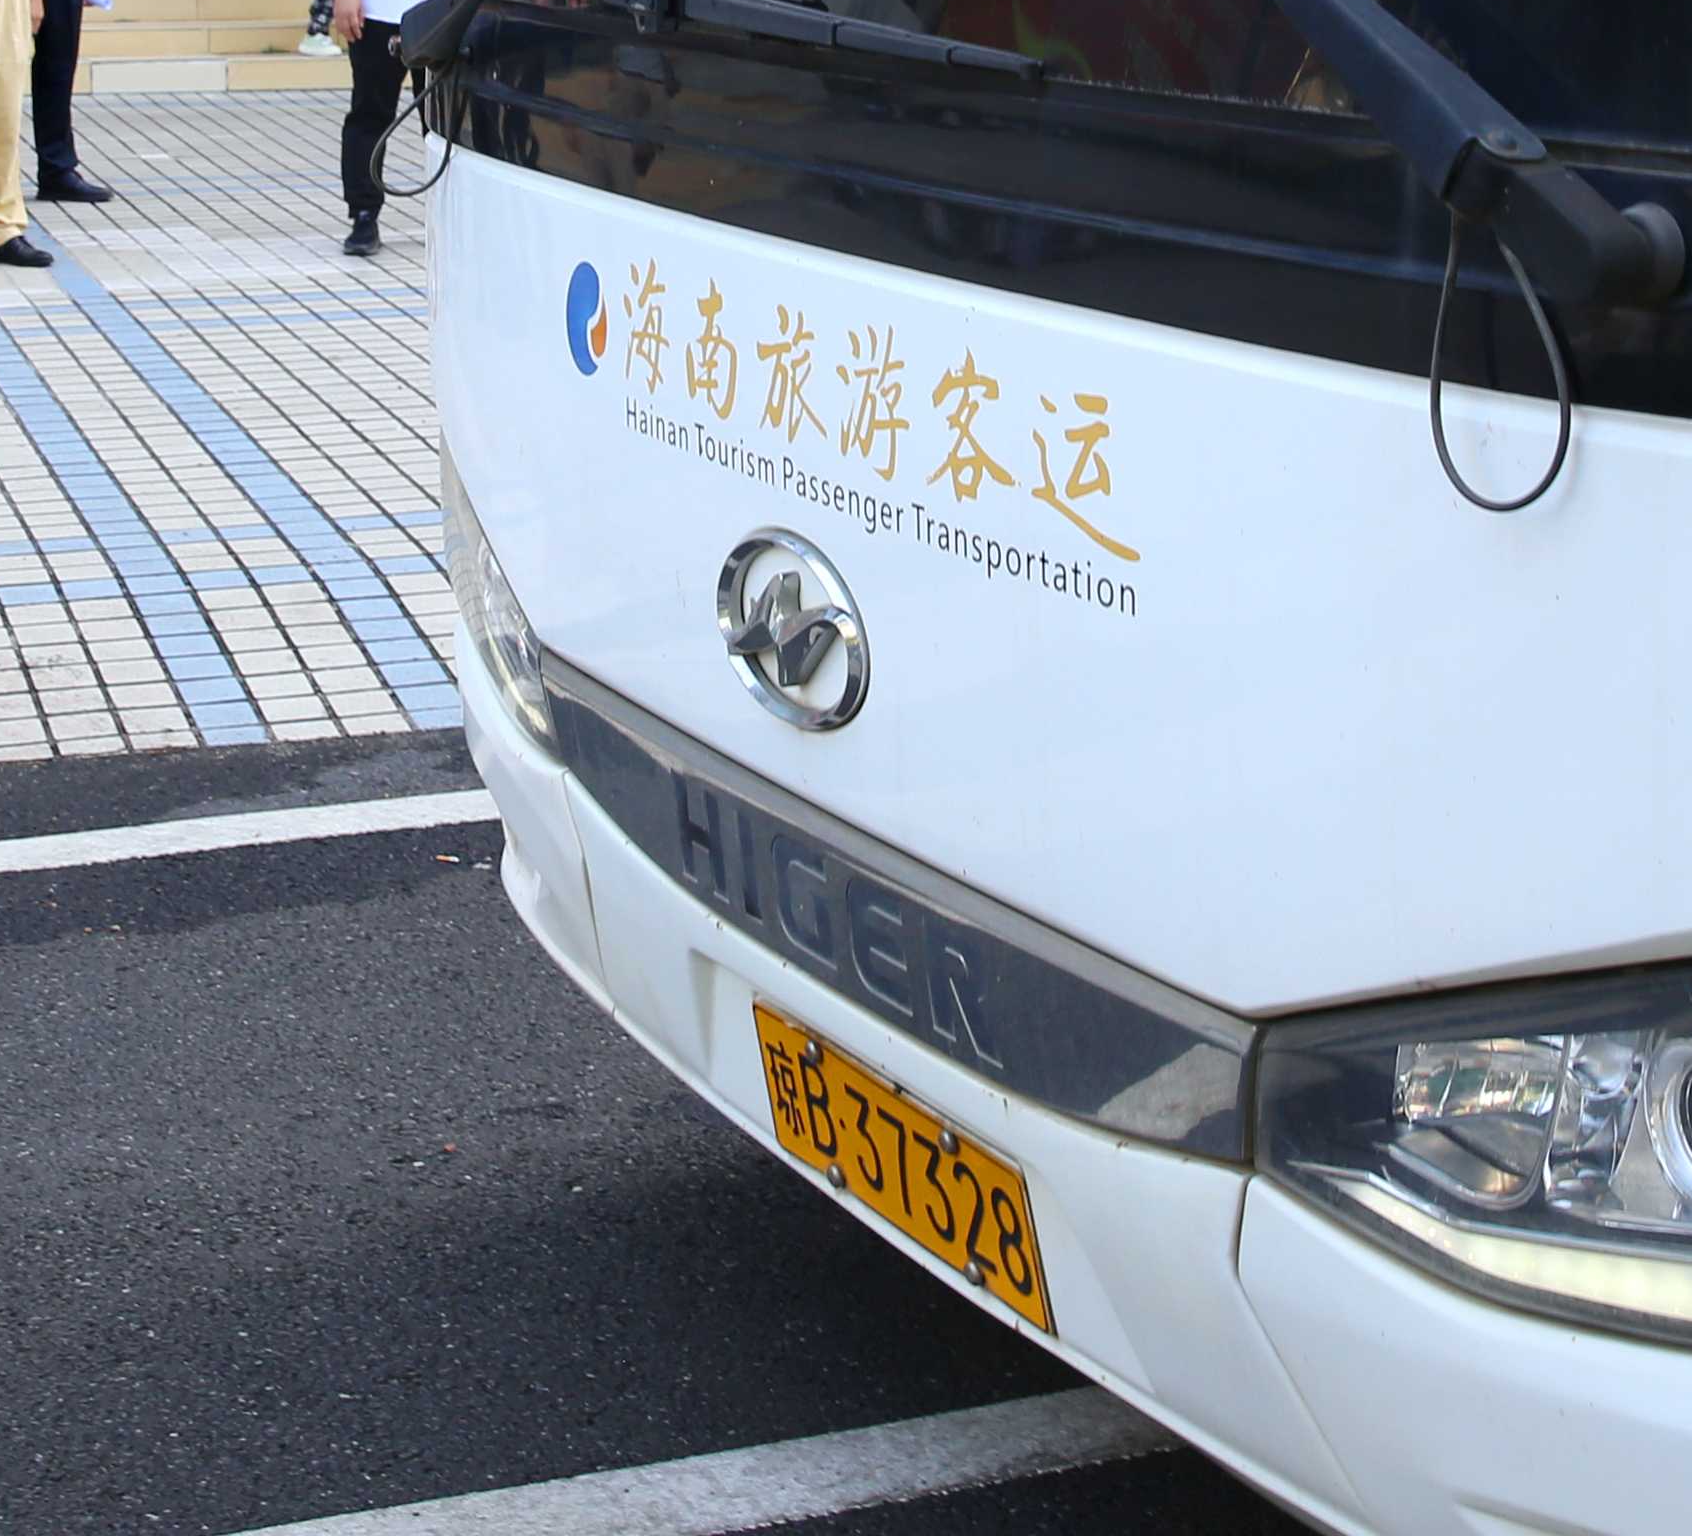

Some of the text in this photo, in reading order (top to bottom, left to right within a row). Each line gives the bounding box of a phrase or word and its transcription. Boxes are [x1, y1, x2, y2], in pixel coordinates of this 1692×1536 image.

[623, 258, 1141, 562] 海南旅游客运
[625, 396, 1137, 617] Hainan Tourism Passenger Transportation
[671, 768, 1004, 1070] HIGER
